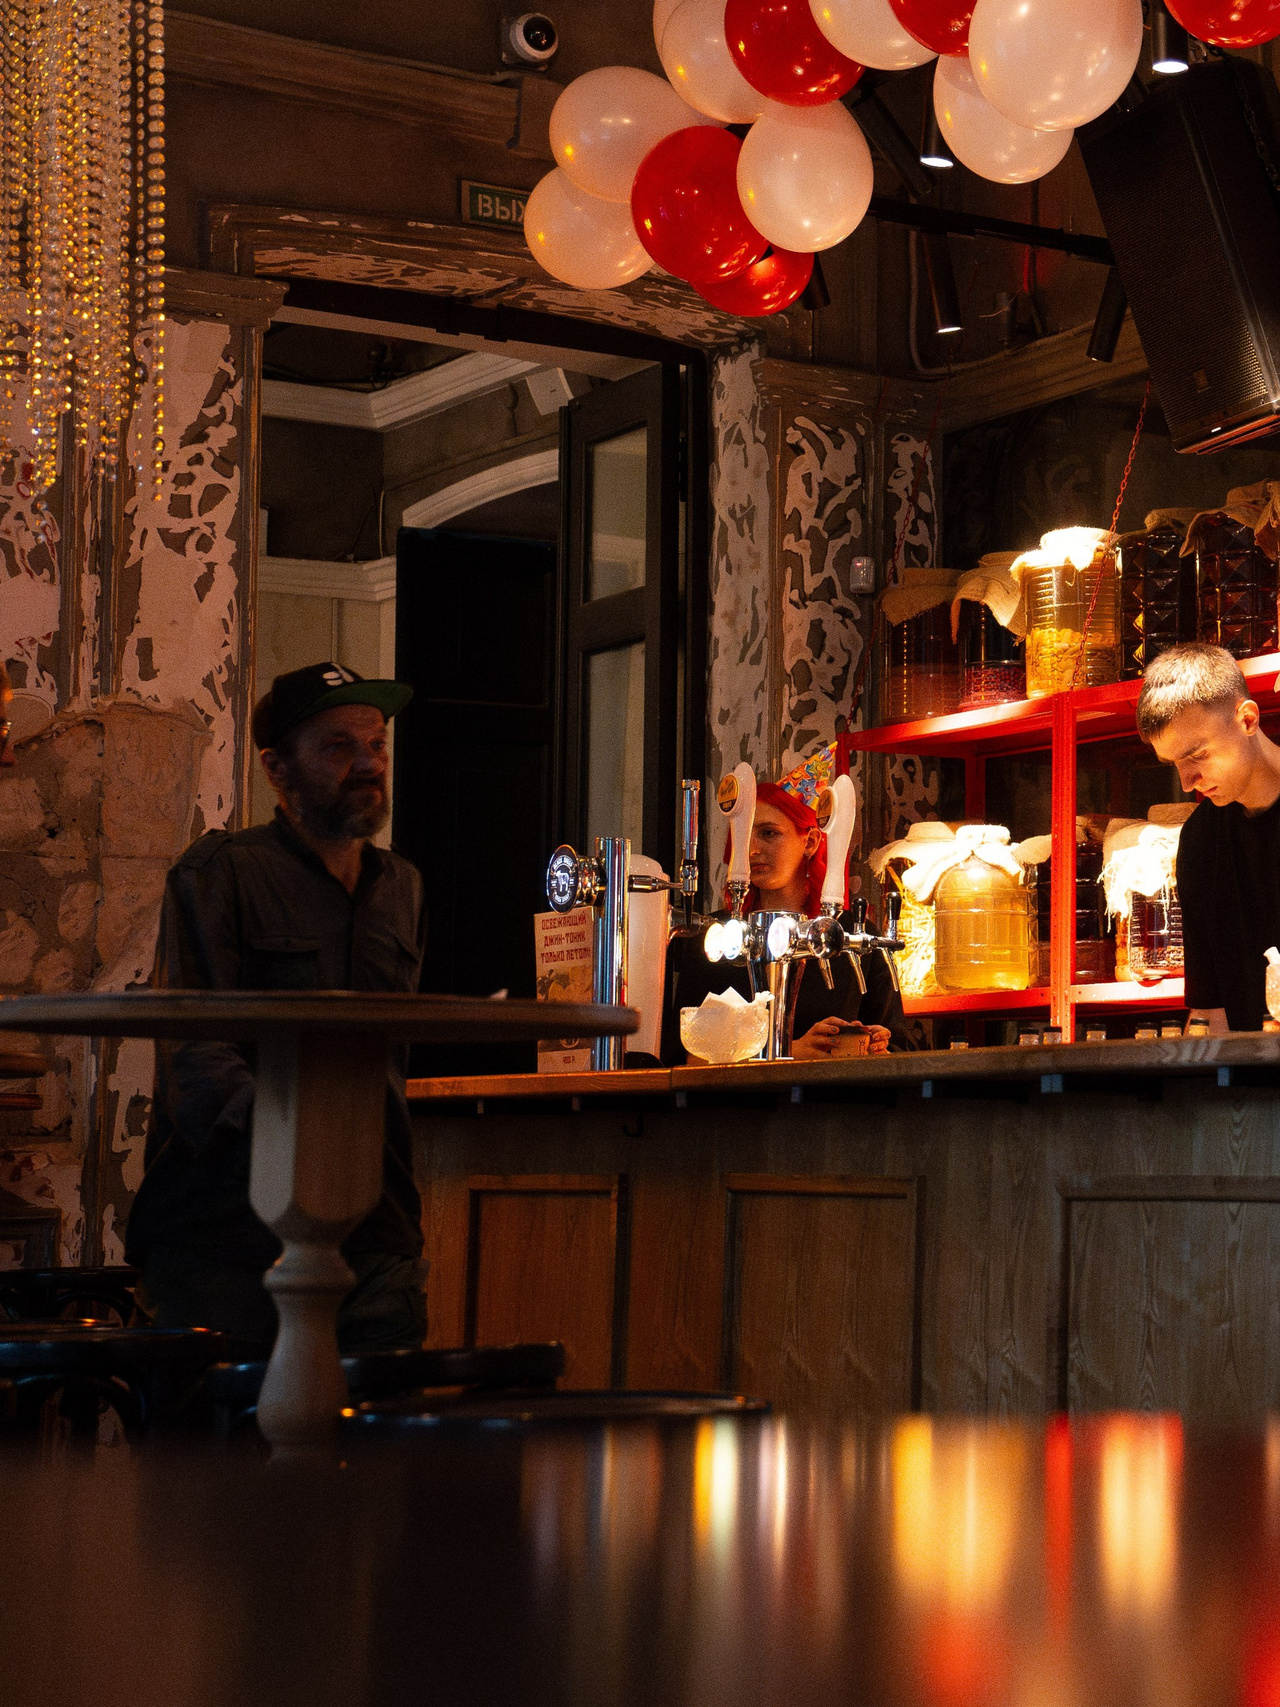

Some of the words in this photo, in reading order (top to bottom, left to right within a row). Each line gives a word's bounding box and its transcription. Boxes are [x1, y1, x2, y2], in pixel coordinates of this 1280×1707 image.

[477, 193, 526, 223] ВЫХ
[541, 910, 587, 931] ОСВЕЖАЮЩИЙ
[543, 931, 586, 948] ДЖИН-ТОНИК
[540, 950, 565, 964] ТОЛЬКО
